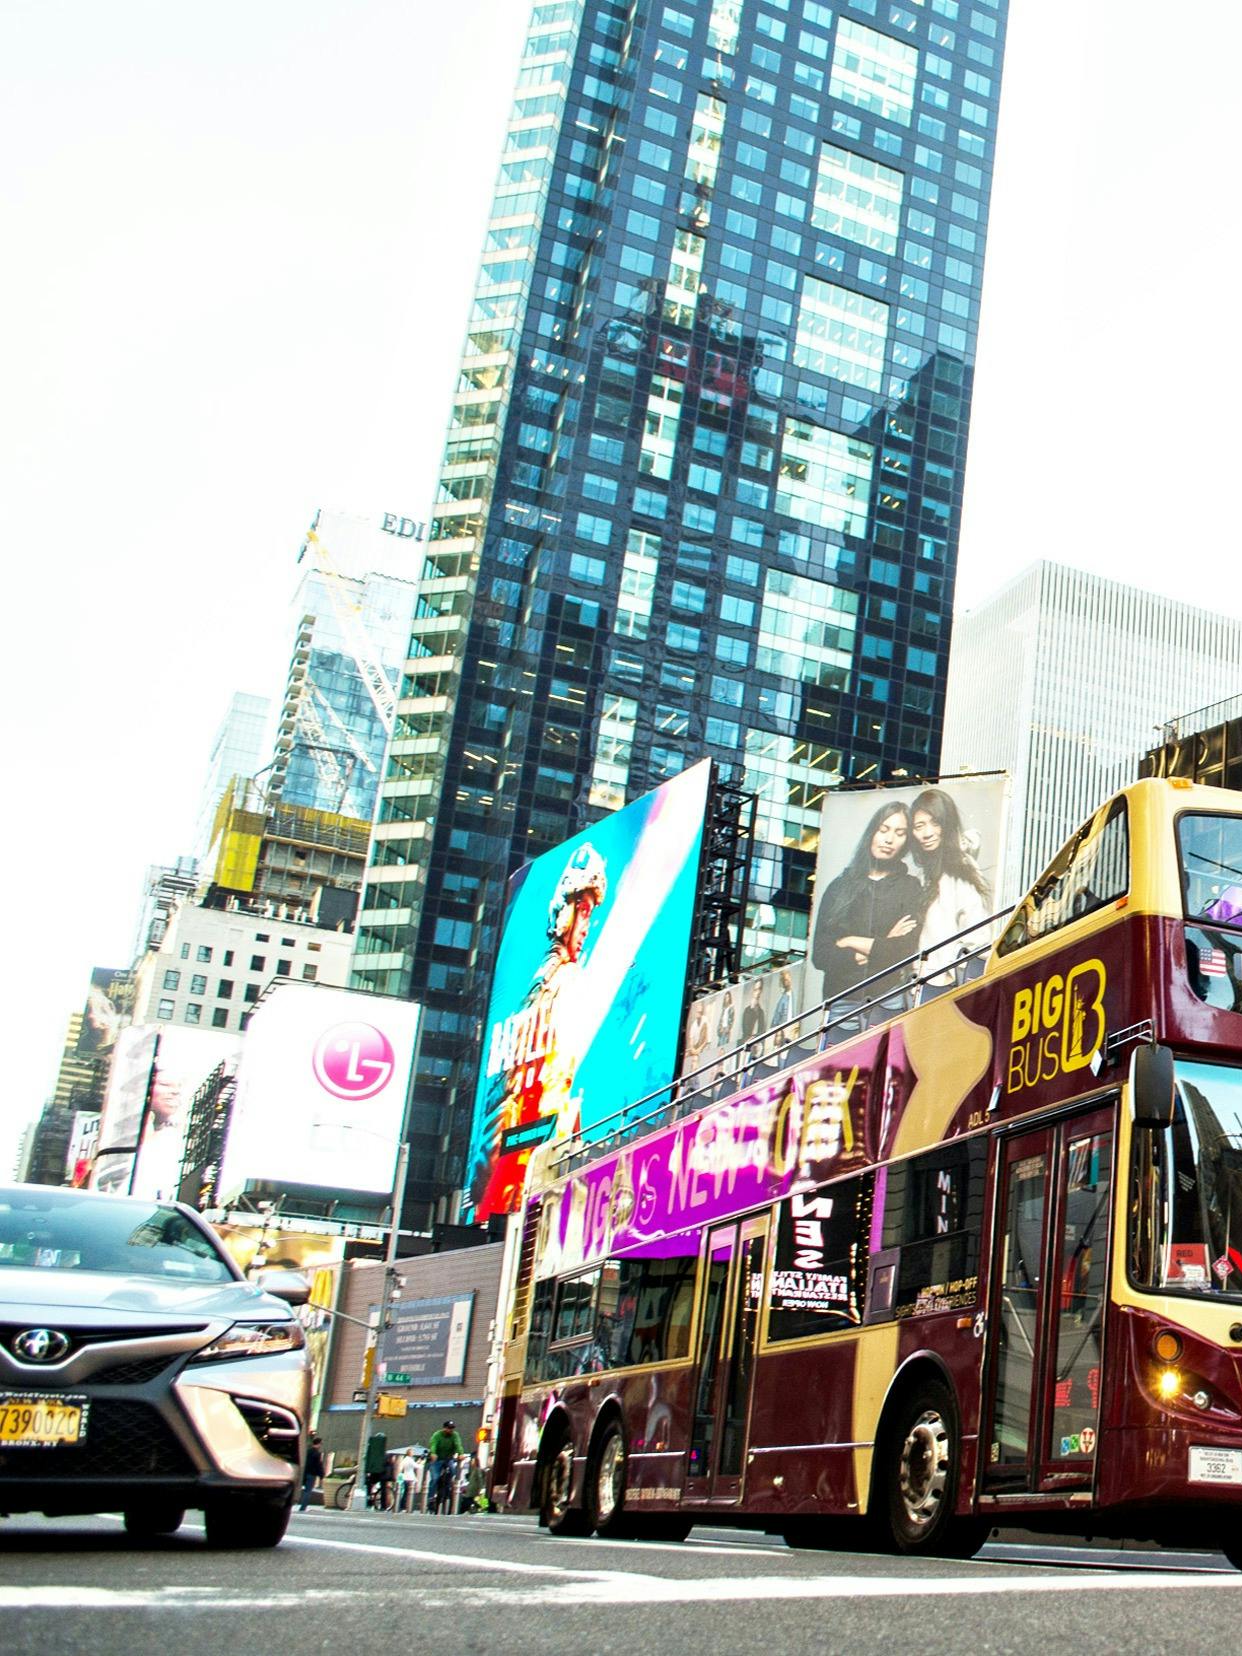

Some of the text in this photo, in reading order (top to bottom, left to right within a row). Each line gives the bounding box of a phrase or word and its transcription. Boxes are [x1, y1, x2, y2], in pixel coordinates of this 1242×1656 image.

[1011, 974, 1064, 1043] BIG
[312, 1021, 395, 1101] LG
[1007, 1032, 1060, 1094] BUS
